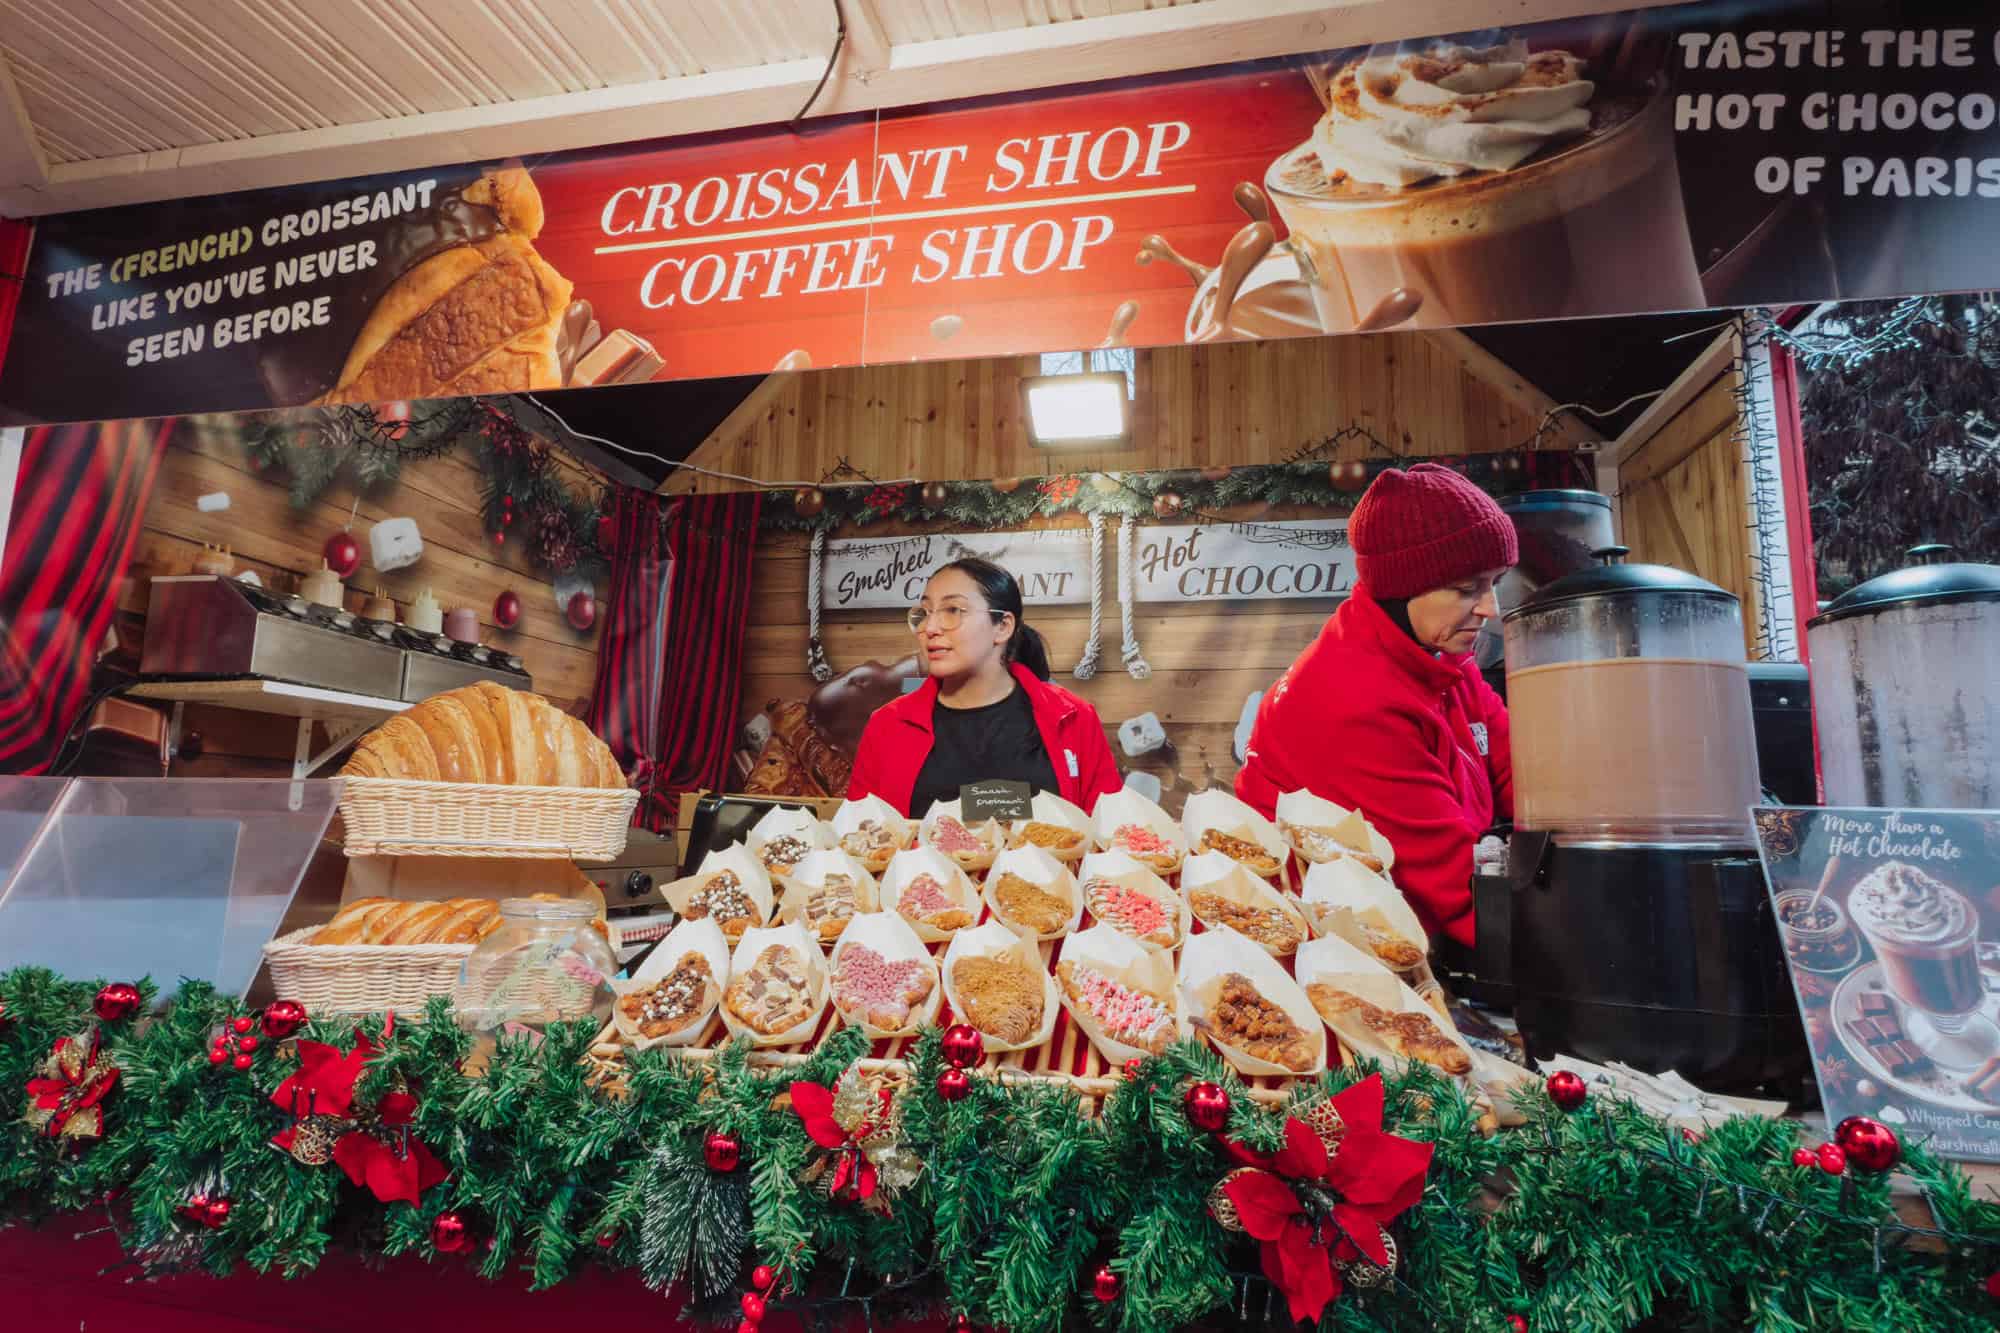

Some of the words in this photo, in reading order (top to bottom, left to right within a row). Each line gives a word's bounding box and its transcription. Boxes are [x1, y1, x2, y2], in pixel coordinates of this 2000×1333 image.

[1678, 30, 1845, 69] TASTE
[1861, 29, 1975, 68] THE
[1674, 93, 1786, 131] HOT
[1801, 92, 2000, 131] CHOCO
[600, 144, 968, 236] CROISSANT
[985, 121, 1191, 194] SHOP
[1754, 156, 1826, 195] OF
[1842, 156, 2000, 198] PARIS
[47, 263, 103, 299] THE
[110, 226, 253, 283] (FRENCH)
[261, 178, 437, 247] CROISSANT
[639, 234, 895, 309] COFFEE
[911, 215, 1114, 284] SHOP
[91, 291, 158, 331] LIKE
[165, 265, 267, 314] YOU'VE
[274, 239, 378, 289] NEVER
[126, 324, 206, 367] SEEN
[213, 296, 331, 348] BEFORE
[838, 536, 933, 604] Smashed
[1141, 527, 1202, 582] Hot
[1177, 562, 1351, 597] CHOCOL
[1821, 814, 1873, 836] More
[1880, 811, 1926, 834] Than
[1929, 822, 1944, 835] a
[1829, 836, 1863, 857] Hot
[1867, 833, 1962, 860] Chocolate
